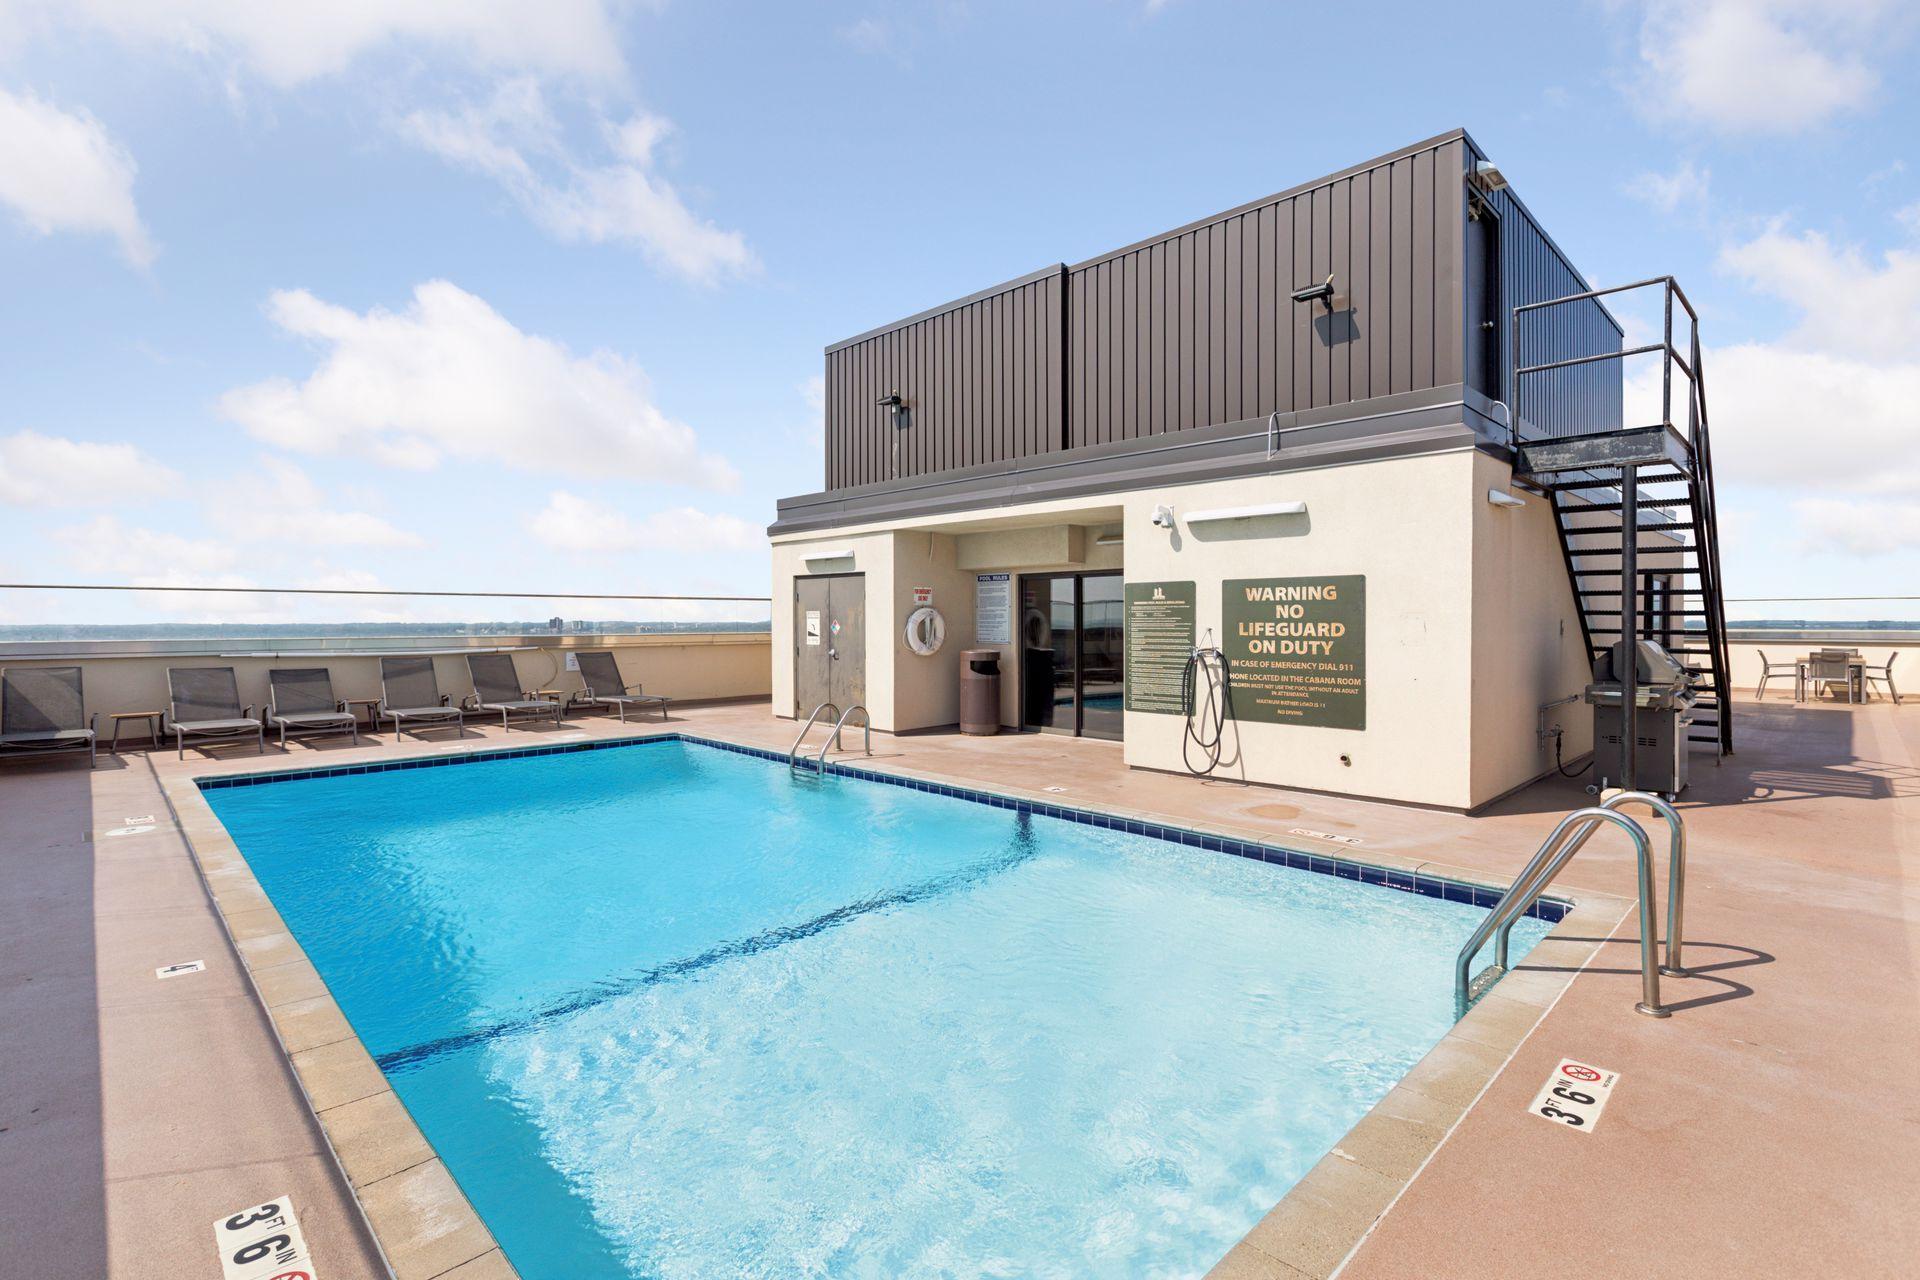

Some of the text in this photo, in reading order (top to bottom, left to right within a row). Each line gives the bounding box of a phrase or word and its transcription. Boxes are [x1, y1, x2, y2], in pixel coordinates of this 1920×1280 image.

[1245, 585, 1337, 602] WARNING
[1275, 604, 1304, 619] NO
[1238, 622, 1346, 638] LIFEGUARD
[1248, 639, 1334, 656] ON DUTY
[1231, 659, 1354, 671] IN CASE OF EMERGENCY DIAL 911
[1250, 674, 1280, 682] LOCATED
[1290, 675, 1304, 683] THE
[1305, 676, 1336, 685] CABANA
[1337, 678, 1361, 686] ROOM
[1540, 1078, 1596, 1126] 3 FT 6 IN
[225, 1203, 298, 1265] 3 FT 6 IN
